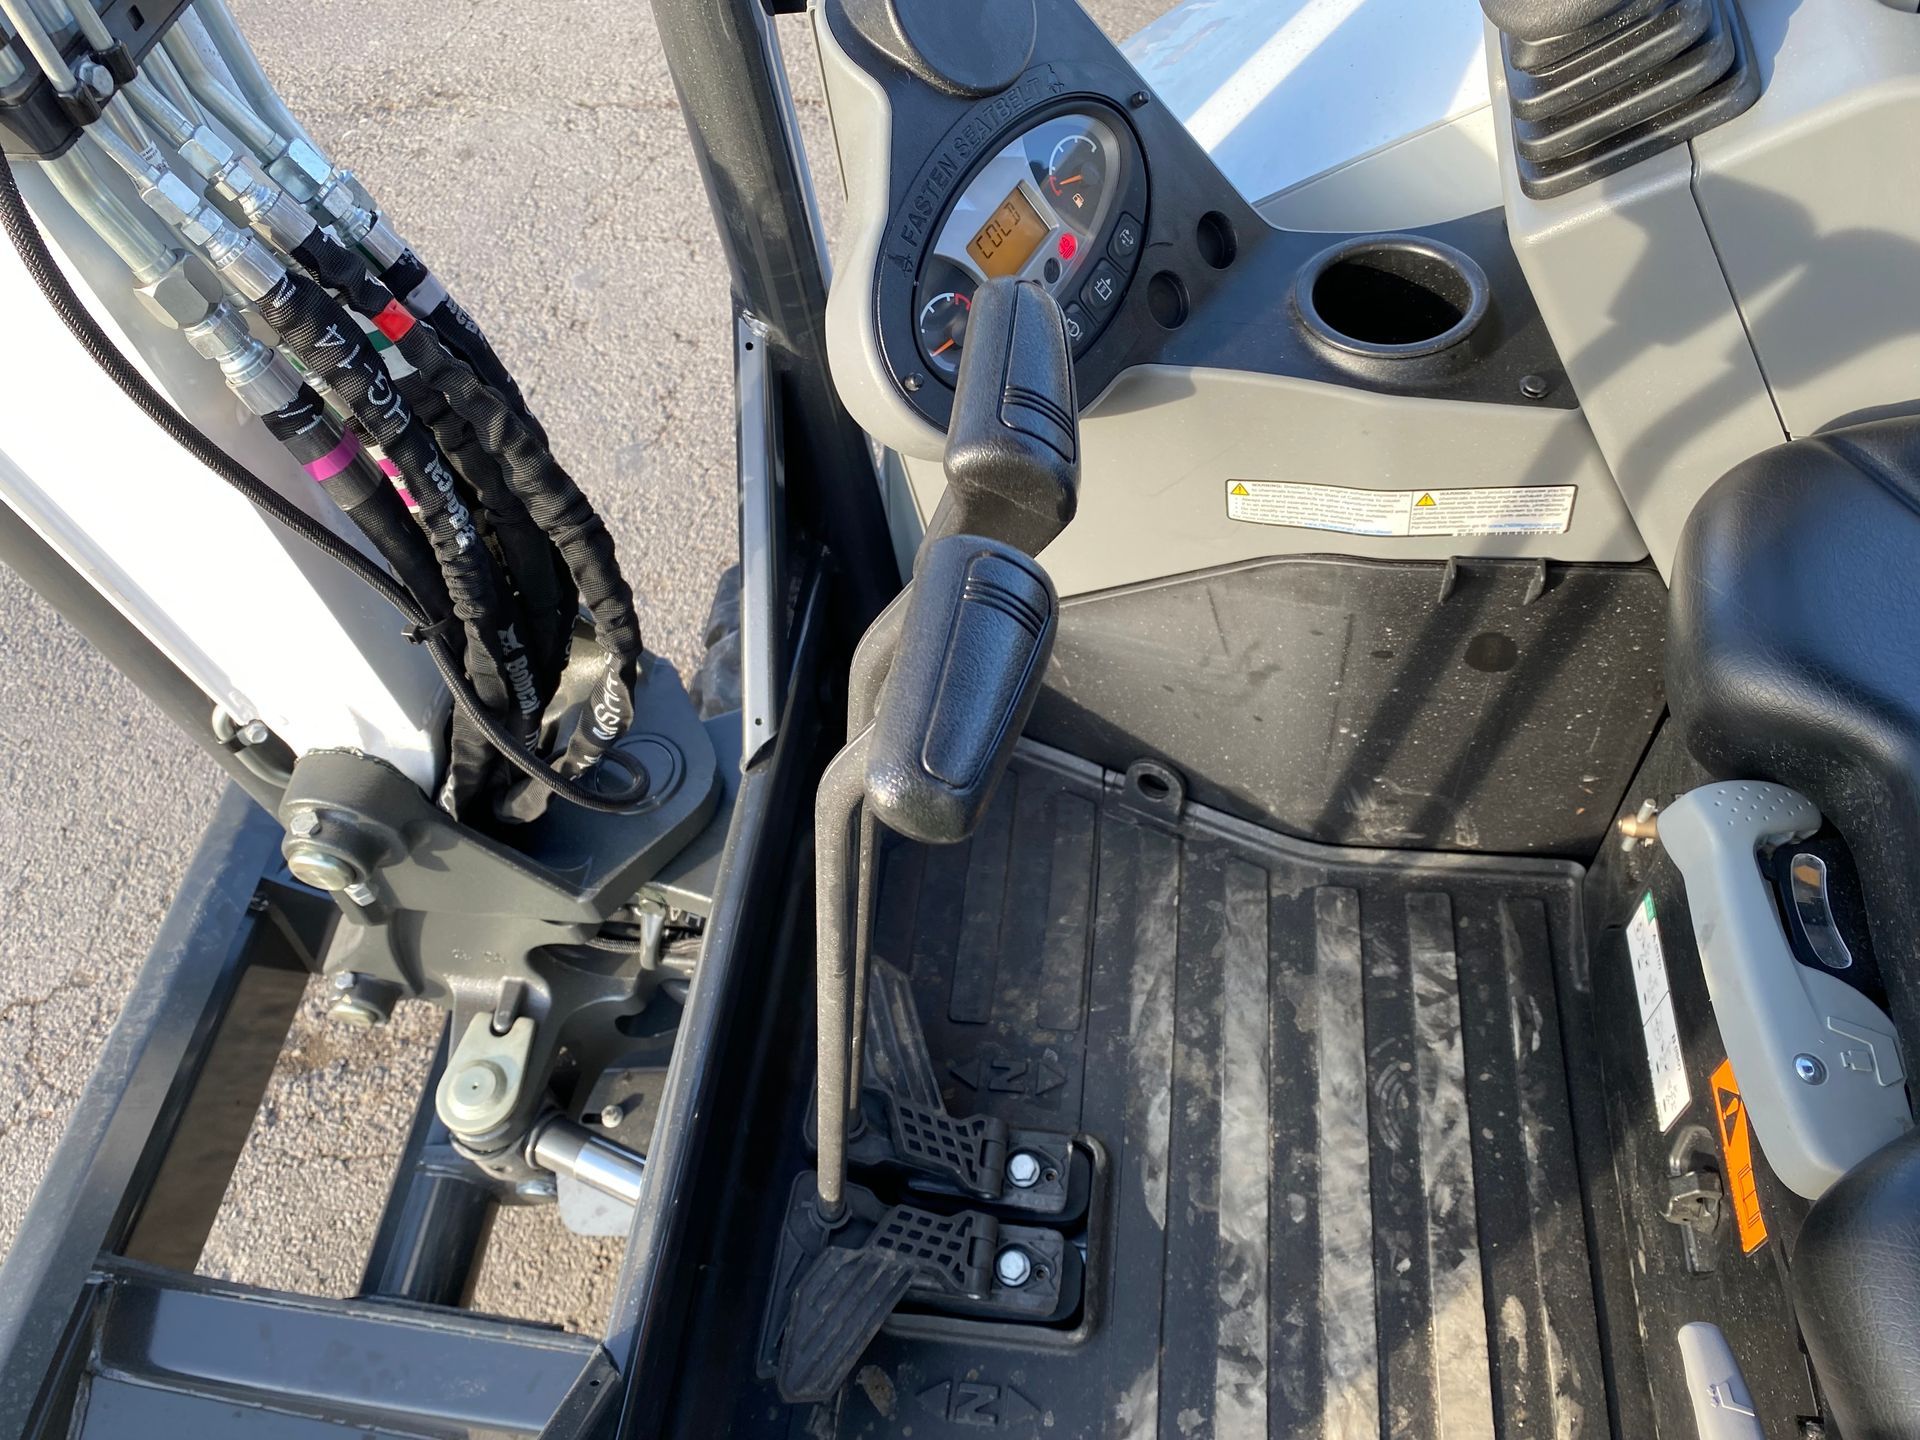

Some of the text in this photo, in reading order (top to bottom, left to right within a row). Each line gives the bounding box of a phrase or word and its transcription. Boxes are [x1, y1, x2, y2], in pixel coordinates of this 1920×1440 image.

[901, 77, 1040, 247] FASTEN SEATBELT
[976, 201, 1021, 259] COLD
